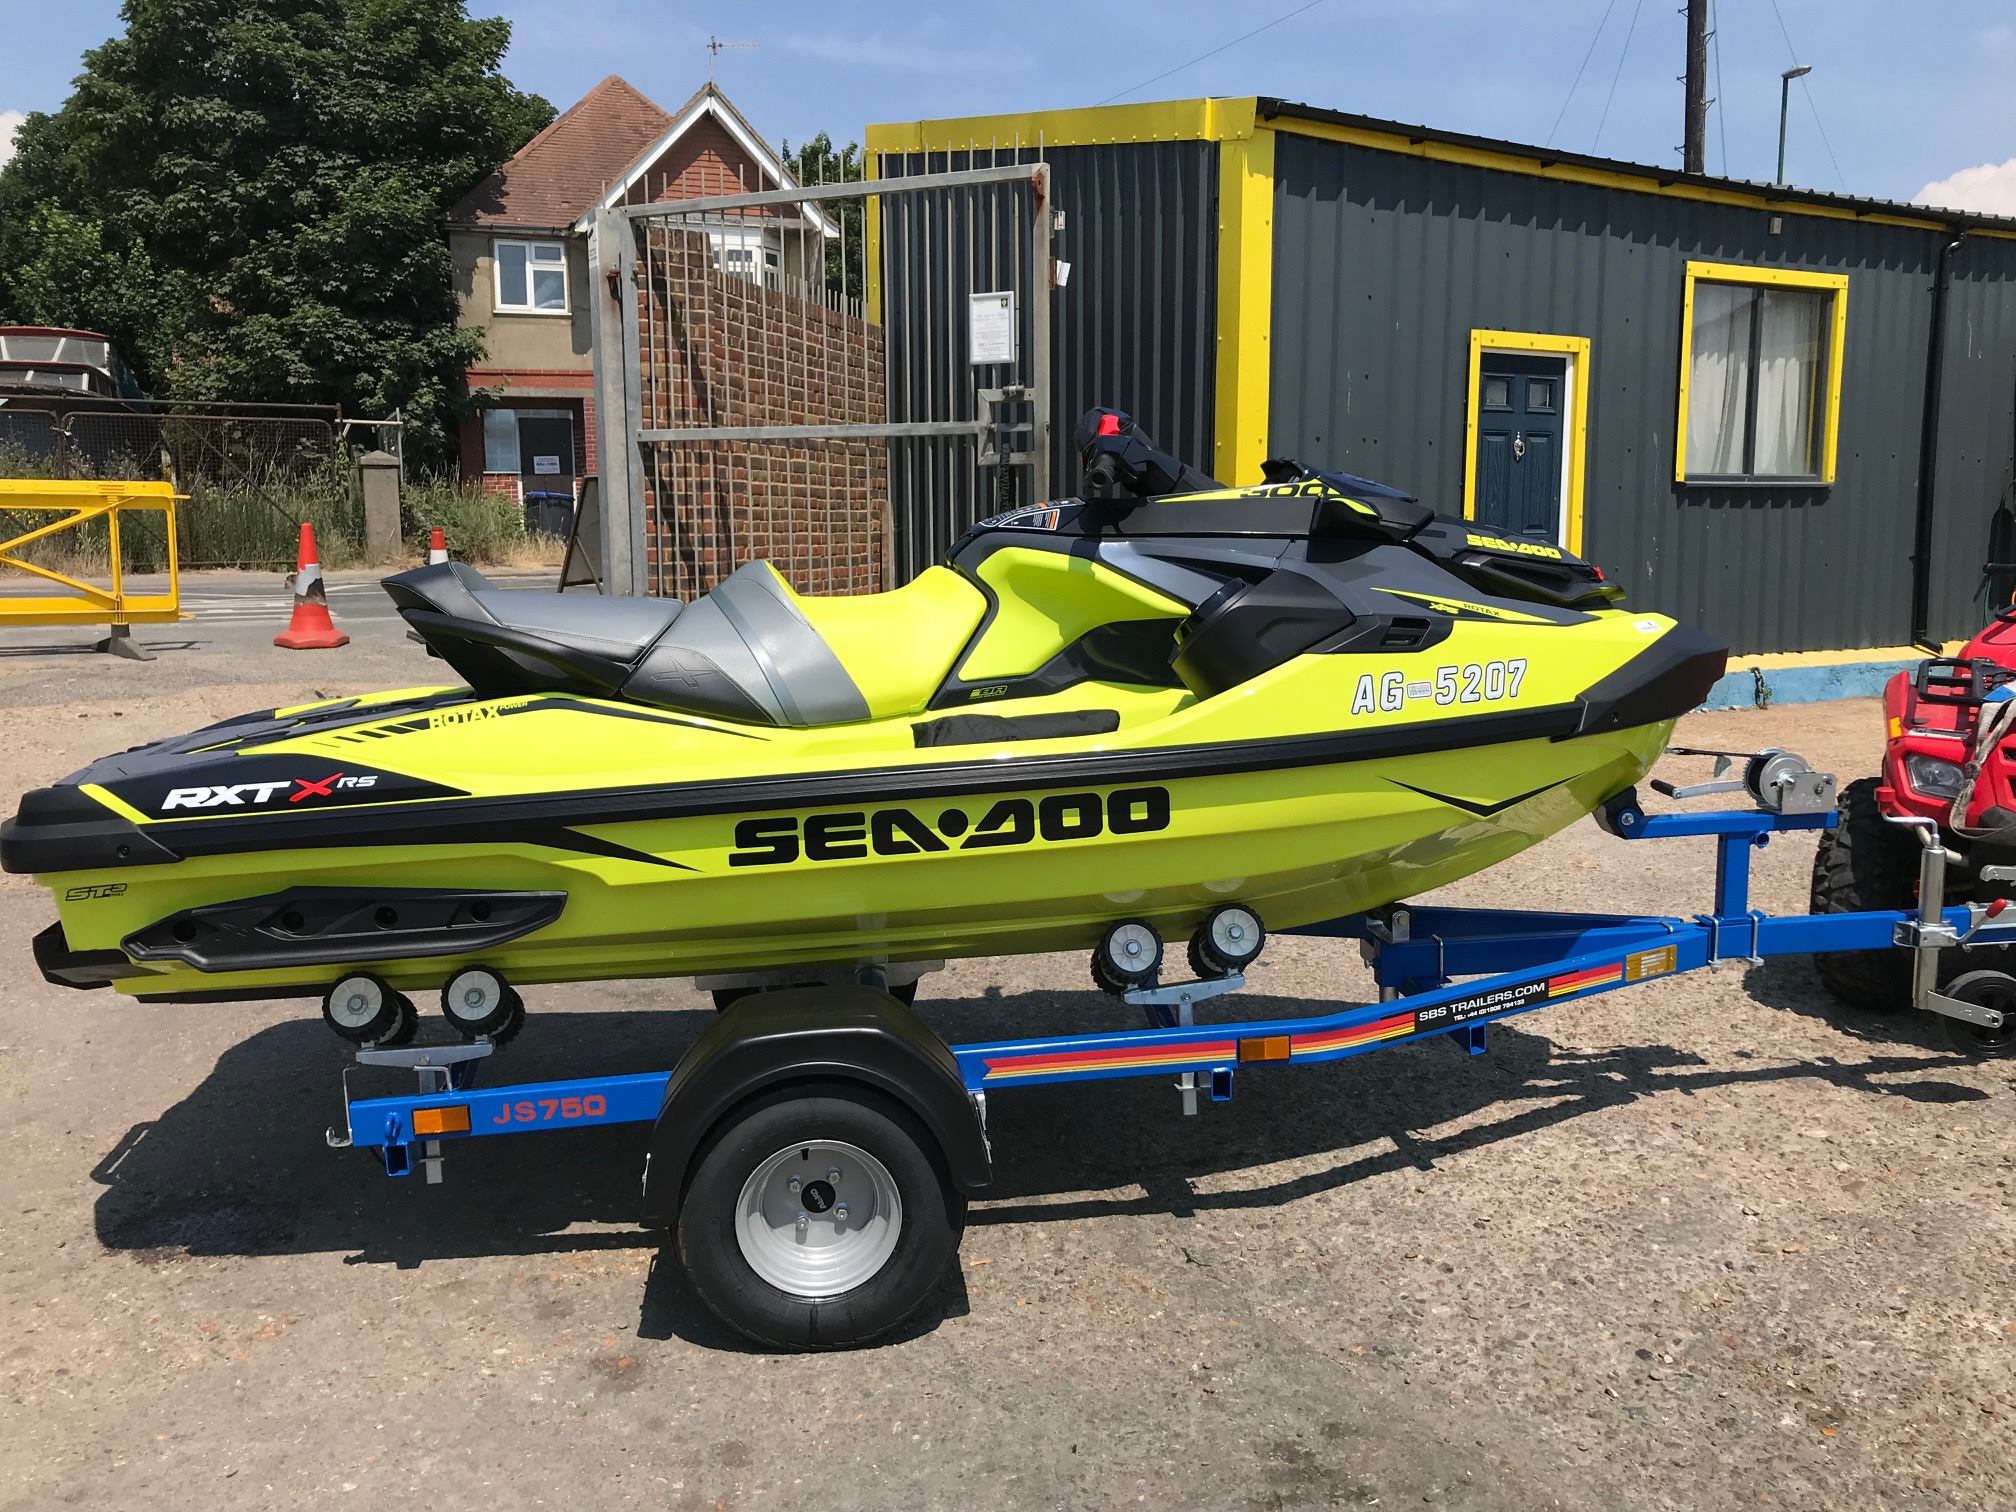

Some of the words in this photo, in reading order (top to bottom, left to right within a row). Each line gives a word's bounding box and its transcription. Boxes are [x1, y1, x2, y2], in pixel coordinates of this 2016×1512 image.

[1463, 603, 1501, 617] ROTAX
[429, 704, 501, 730] ROTAX
[161, 780, 292, 810] RXT
[336, 775, 378, 789] RS
[1419, 1006, 1447, 1022] SBS
[1450, 982, 1545, 1014] TRAILERS.COM
[493, 1094, 606, 1125] JS750
